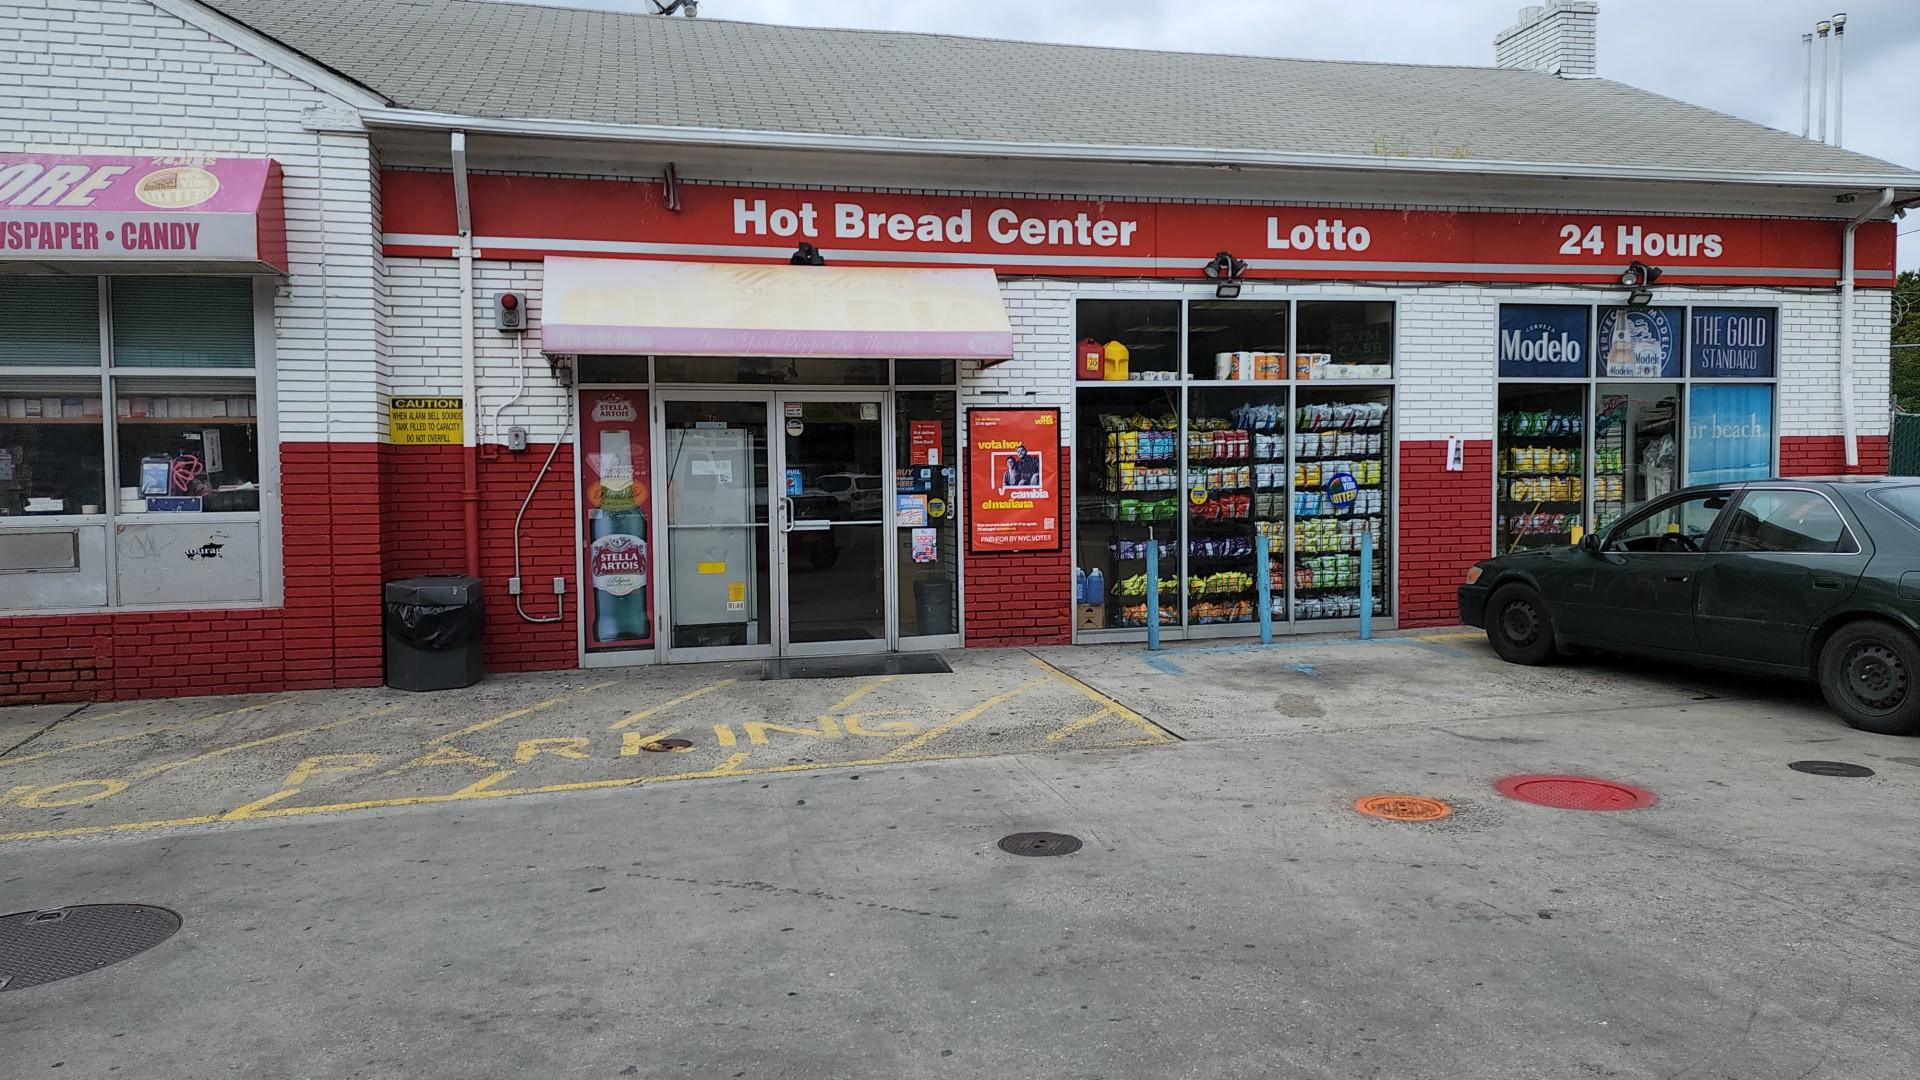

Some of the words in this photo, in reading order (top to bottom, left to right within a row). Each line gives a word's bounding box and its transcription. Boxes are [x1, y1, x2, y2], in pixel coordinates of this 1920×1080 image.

[0, 163, 132, 207] ORE
[733, 198, 818, 237] Hot
[834, 203, 972, 242] Bread
[987, 208, 1137, 246] Center
[121, 222, 200, 250] CANDY
[1267, 217, 1370, 252] Lotto
[1559, 224, 1604, 255] 24
[1617, 225, 1723, 258] Hours
[1526, 323, 1555, 334] CERVEZA
[1648, 309, 1669, 360] MODELO
[1693, 316, 1722, 346] THE
[1727, 316, 1766, 347] GOLD
[1501, 329, 1580, 362] Modelo
[1702, 349, 1757, 369] STANDARD
[395, 400, 458, 408] CAUTION
[393, 412, 406, 420] WHEN
[409, 412, 426, 420] ALARM
[428, 412, 439, 420] BELL
[441, 412, 463, 420] SOUNDS
[396, 423, 408, 431] TANK
[410, 423, 426, 431] FILLED
[429, 423, 435, 431] TO
[437, 423, 461, 431] CAPACITY
[428, 434, 450, 442] OVERFILL
[978, 441, 1002, 450] vota
[1002, 440, 1023, 450] hoy
[1011, 488, 1049, 499] cambia
[982, 500, 991, 510] el
[992, 499, 1034, 509] mañana
[600, 553, 638, 561] STELLA
[600, 561, 639, 570] ARTOIS
[282, 713, 924, 787] PARKING
